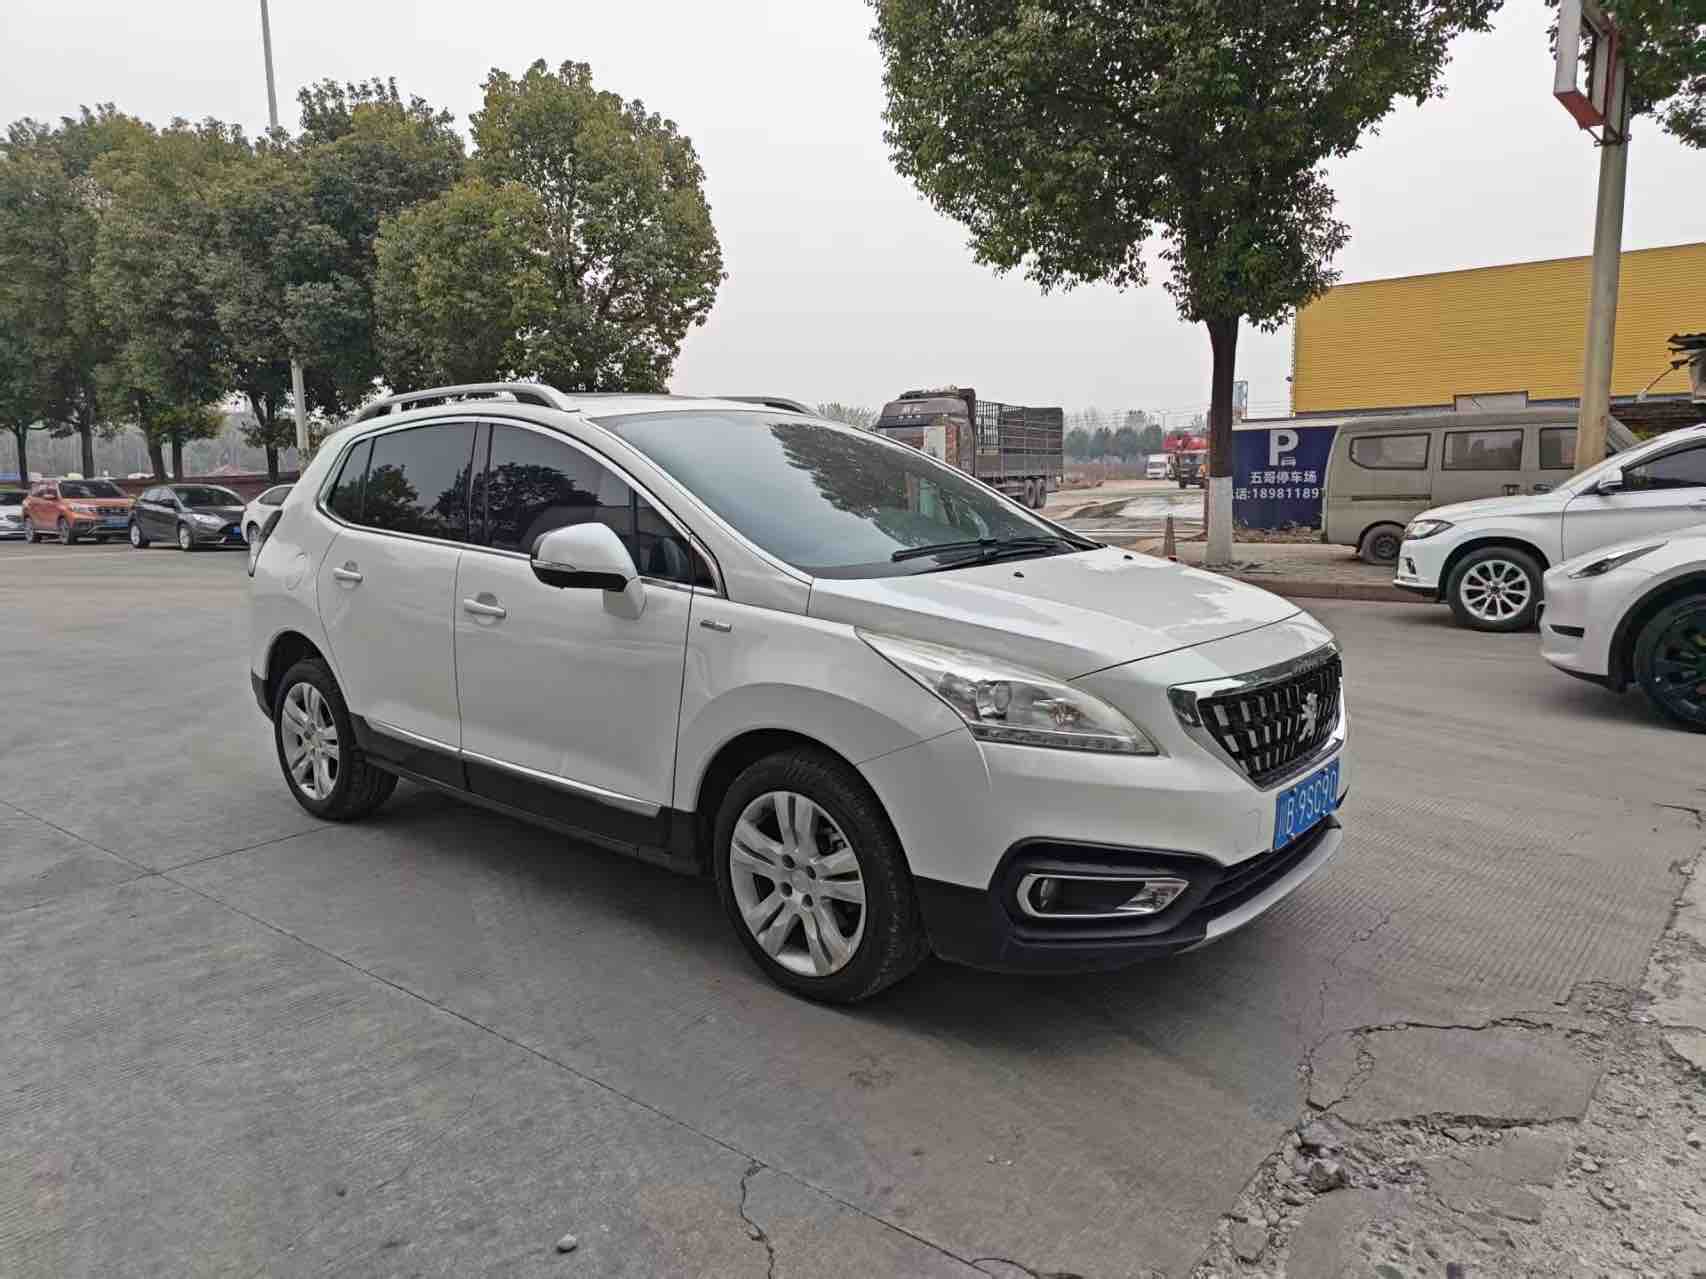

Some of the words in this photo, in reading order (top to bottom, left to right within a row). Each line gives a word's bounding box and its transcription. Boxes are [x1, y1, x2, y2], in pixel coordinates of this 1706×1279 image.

[1269, 429, 1299, 466] P
[1249, 471, 1317, 484] 五哥停车场
